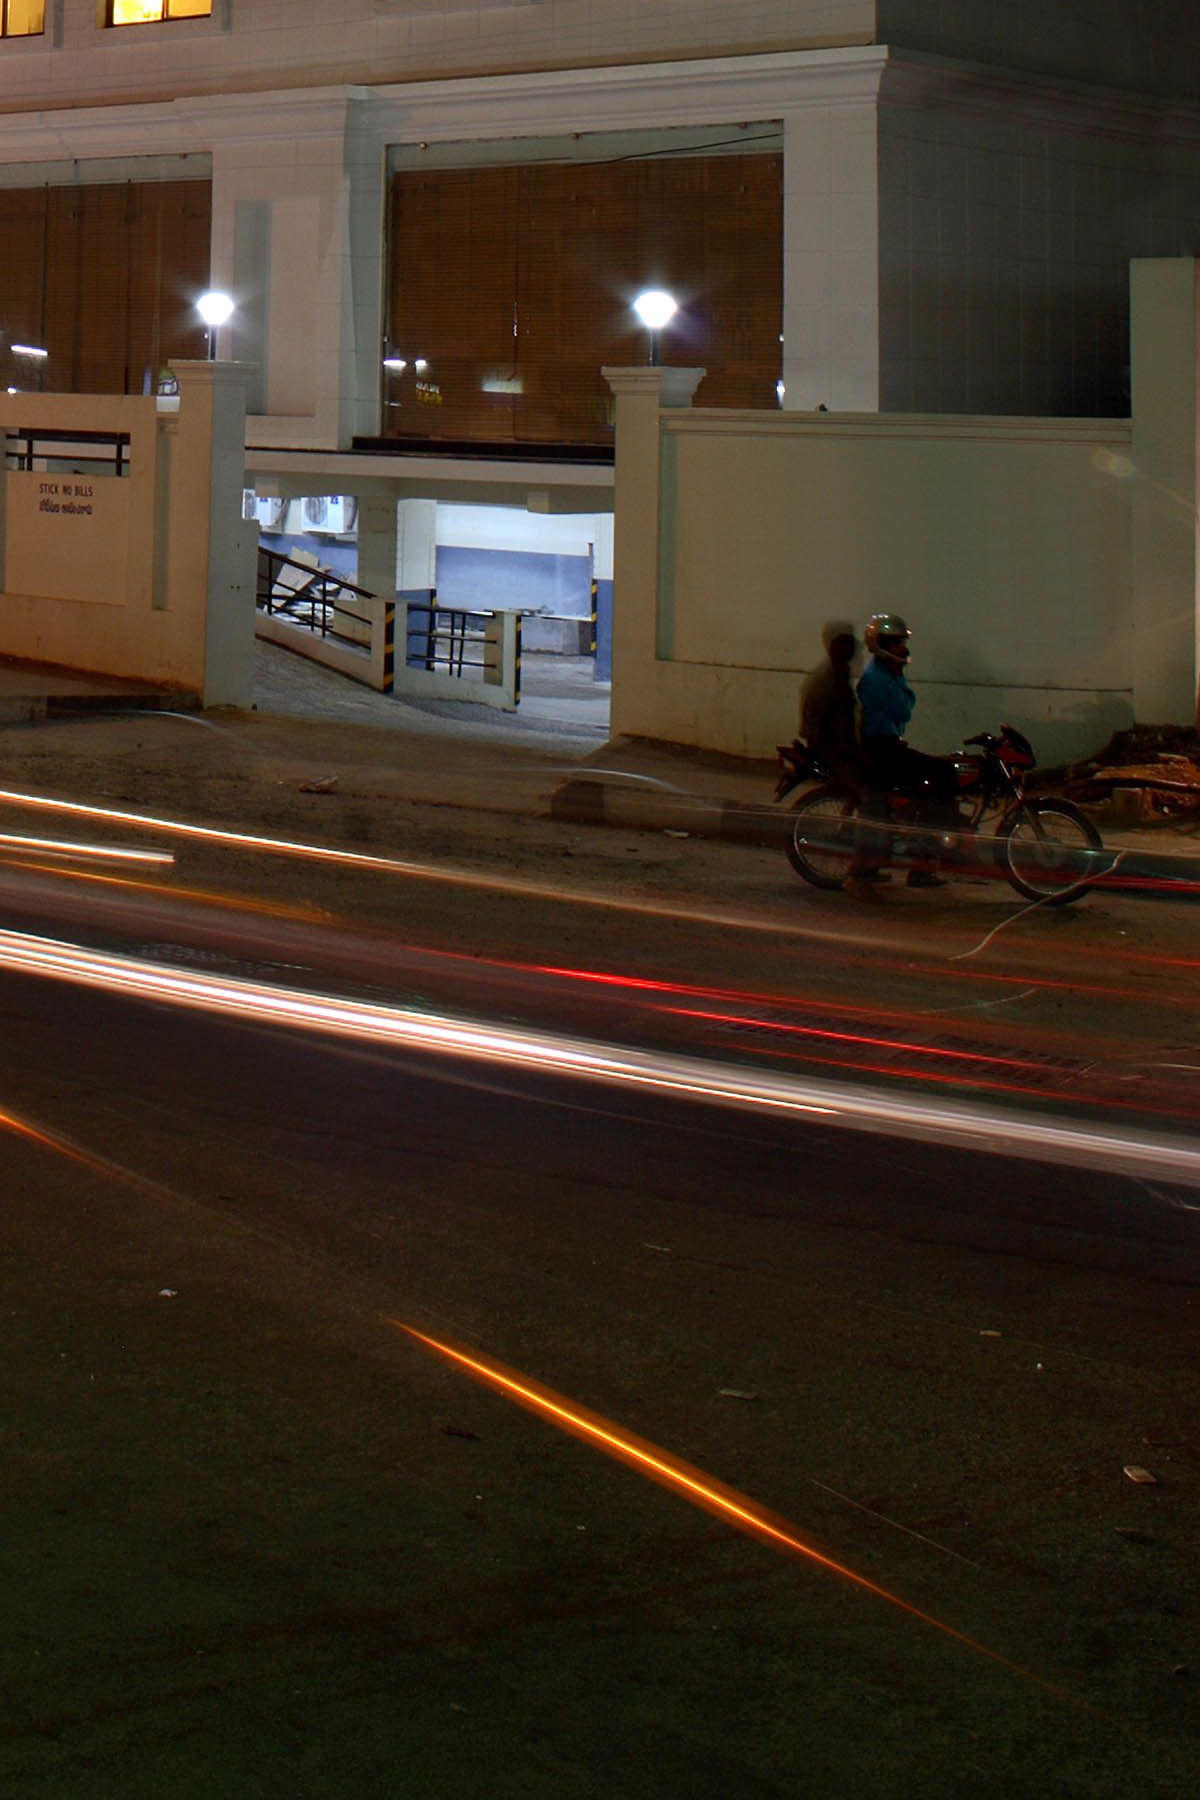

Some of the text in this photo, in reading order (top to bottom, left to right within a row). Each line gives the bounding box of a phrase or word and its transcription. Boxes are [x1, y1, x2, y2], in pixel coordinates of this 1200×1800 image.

[40, 483, 94, 497] STICK NO BILLS
